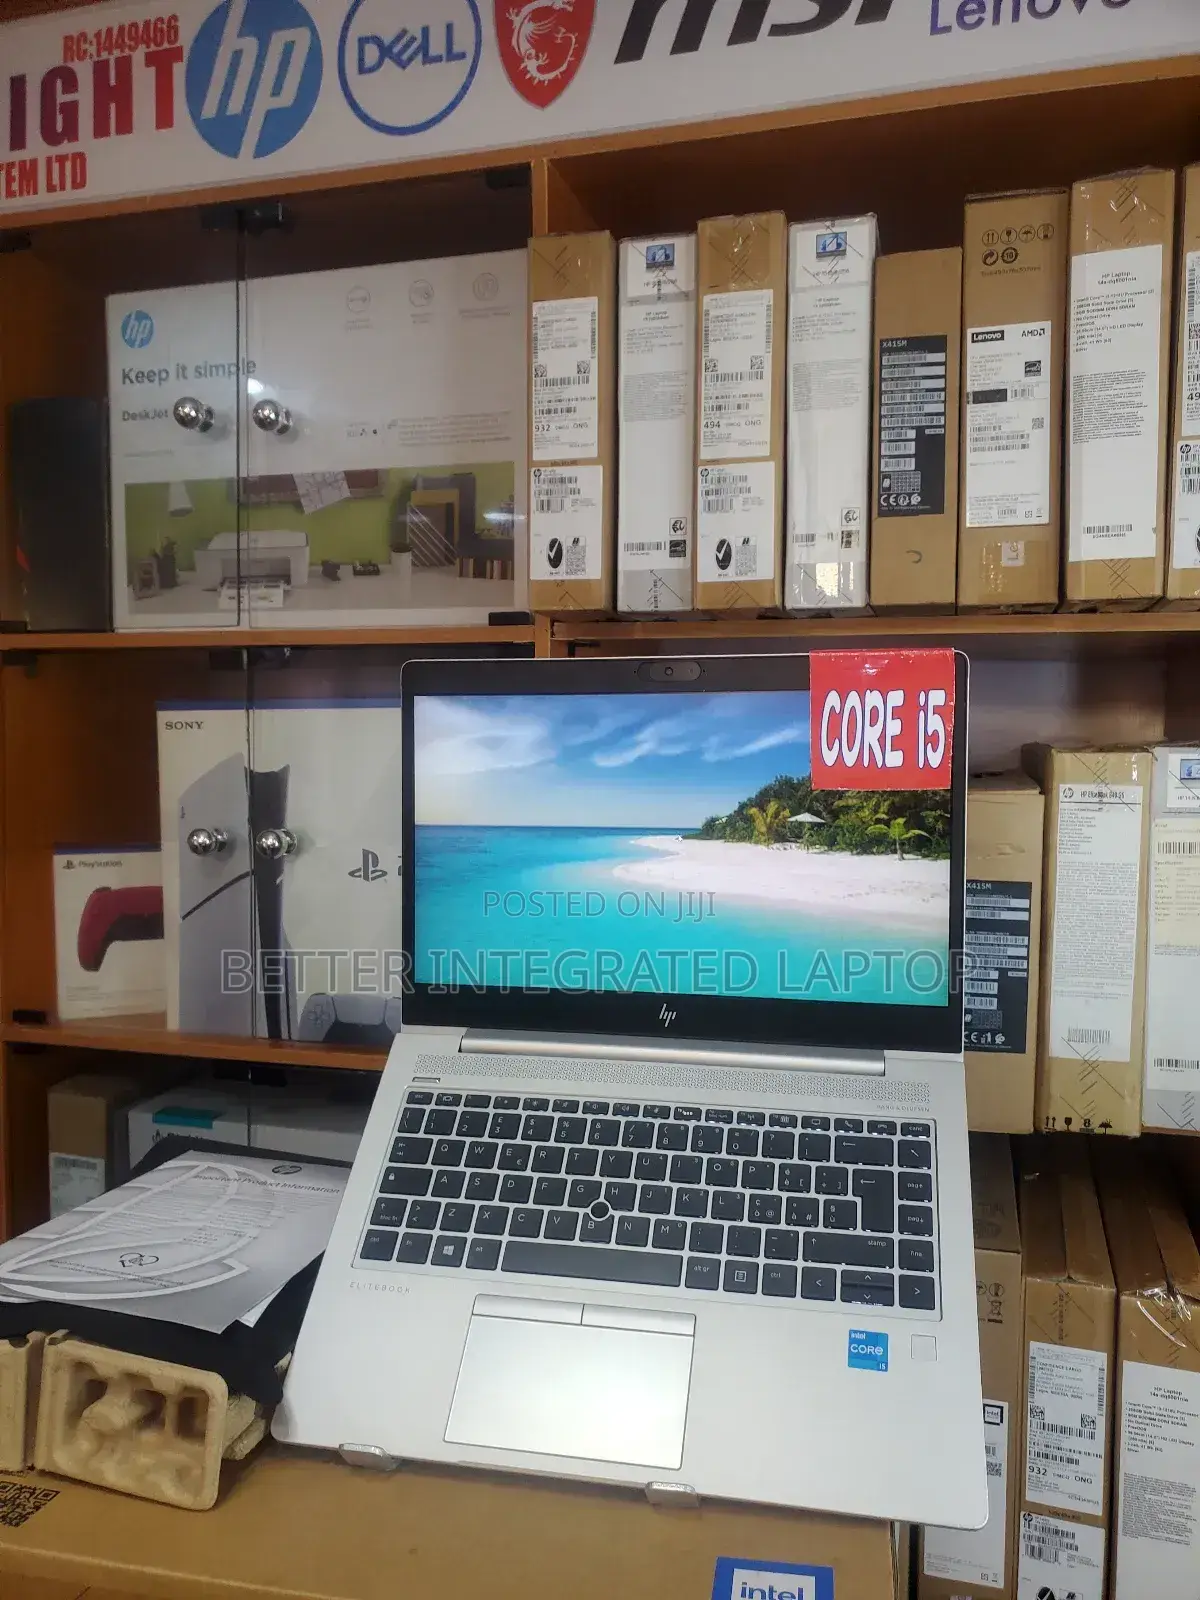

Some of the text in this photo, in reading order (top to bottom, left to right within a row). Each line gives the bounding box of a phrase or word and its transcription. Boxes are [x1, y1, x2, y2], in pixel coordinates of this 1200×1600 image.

[63, 14, 180, 63] RC:1449466
[357, 22, 467, 76] DELL
[9, 46, 184, 152] IGHT
[46, 152, 87, 193] LTD
[125, 310, 151, 348] hp
[1021, 329, 1039, 337] AMD
[973, 332, 1002, 341] Lenovo
[122, 357, 257, 386] Keep it simple
[534, 424, 551, 432] 932
[165, 721, 204, 730] SONY
[820, 688, 947, 769] CORE i5
[594, 1132, 600, 1140] 6
[628, 1134, 634, 1142] 7
[441, 1144, 449, 1152] Q
[474, 1146, 484, 1154] W
[506, 1148, 513, 1156] E
[539, 1151, 547, 1159] R
[440, 1175, 448, 1183] A
[474, 1178, 480, 1186] S
[242, 1177, 280, 1187] Product
[281, 1182, 340, 1194] Information
[507, 1180, 515, 1188] D
[541, 1182, 548, 1190] F
[611, 1187, 618, 1195] H
[646, 1190, 653, 1198] J
[683, 1193, 690, 1201] K
[719, 1196, 725, 1204] L
[448, 1208, 456, 1216] Z
[483, 1211, 491, 1219] X
[553, 1216, 560, 1224] V
[587, 1221, 594, 1229] B
[624, 1222, 631, 1230] N
[661, 1225, 670, 1233] M
[349, 1281, 411, 1294] ELITEBOOK
[851, 1332, 866, 1340] intel
[1028, 1465, 1092, 1484] 932 ONG
[740, 1582, 804, 1600] intel
